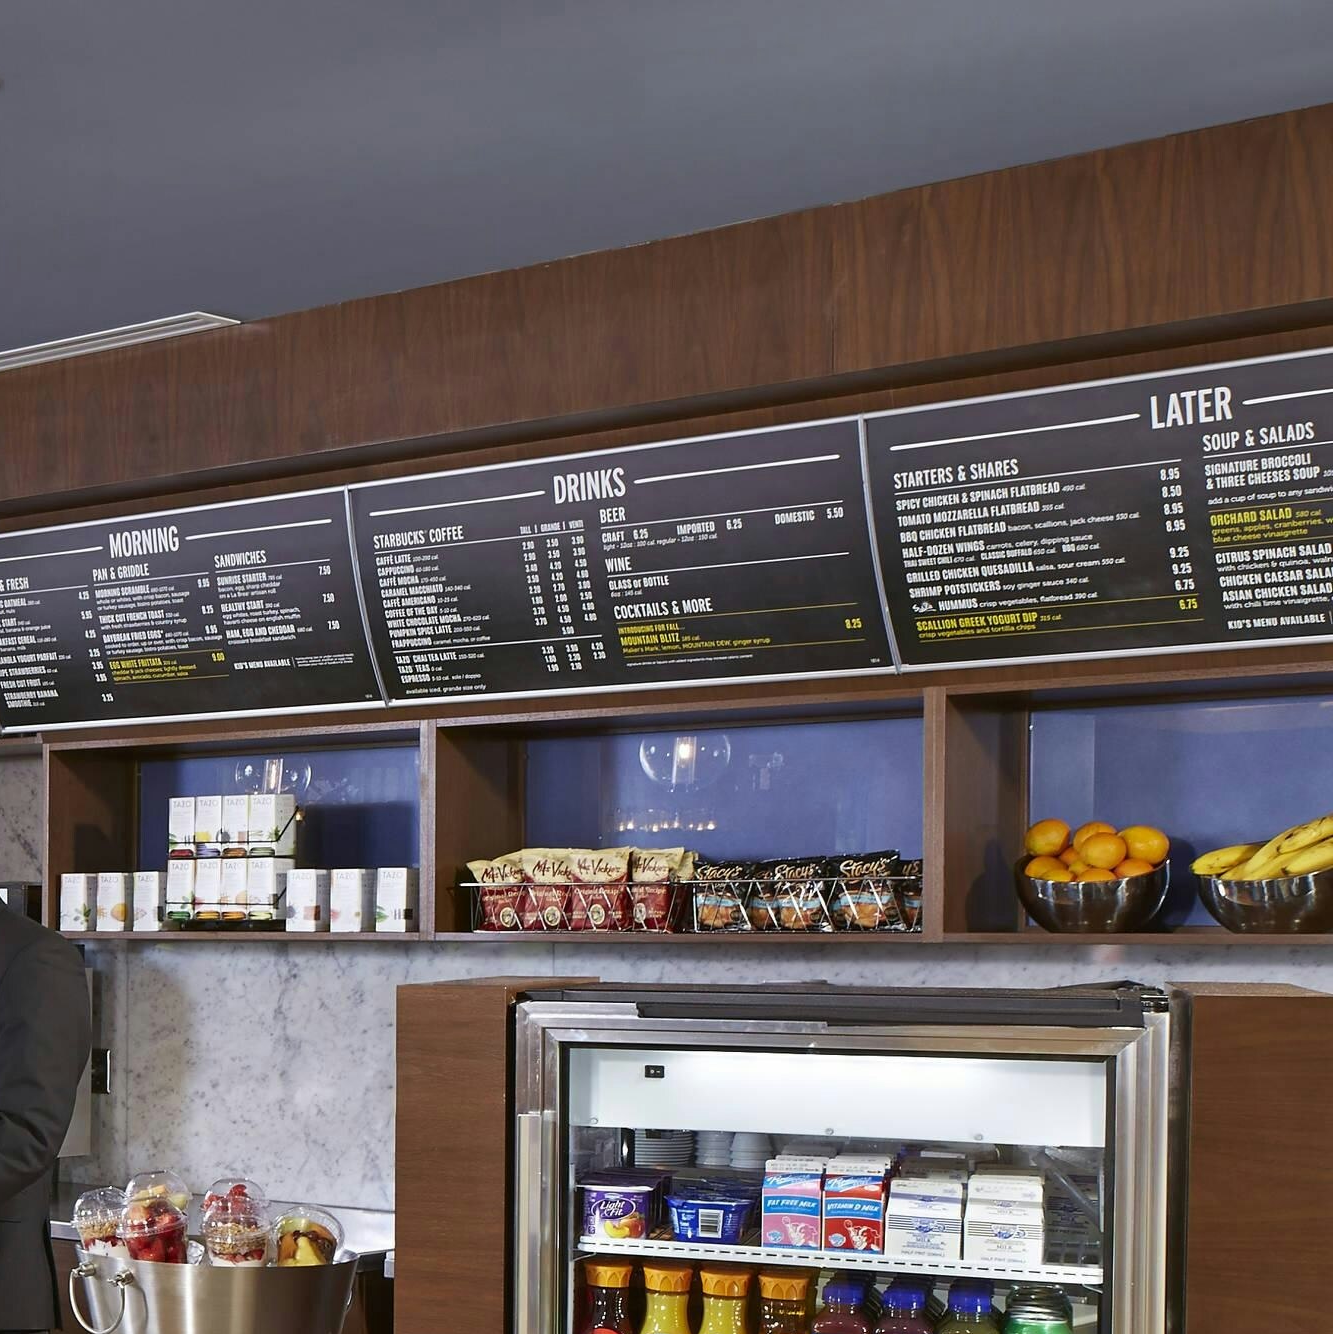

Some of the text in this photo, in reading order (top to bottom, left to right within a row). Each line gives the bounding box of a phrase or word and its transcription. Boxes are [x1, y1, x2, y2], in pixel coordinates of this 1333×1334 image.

[1150, 386, 1233, 429] LATER
[1202, 421, 1315, 452] SOUP & SALADS
[893, 458, 1019, 489] STARTERS & SHARES
[1160, 467, 1180, 481] 8.95
[1204, 453, 1311, 477] SIGNATURE BROCCOLI
[553, 467, 626, 505] DRINKS
[1206, 466, 1320, 490] & THREE CHEESES SOUP
[895, 482, 1060, 511] SPICY CHICKEN & SPINACH FLATBREAD
[1162, 485, 1182, 498] 8.50
[1230, 496, 1246, 504] cup
[1247, 493, 1255, 501] of
[1257, 492, 1277, 501] soup
[1277, 490, 1286, 498] to
[1288, 489, 1303, 497] any
[599, 507, 626, 524] BEER
[897, 501, 1040, 527] TOMATO MOZZARELLA FLATBREAD
[1163, 502, 1184, 516] 8.95
[1210, 507, 1293, 527] ORCHARD SALAD
[601, 507, 844, 544] CRAFT 6.25 IMPORTED 6.25 DOMESTIC 5.50
[900, 522, 1007, 543] BBQ CHICKEN FLATBREAD
[1165, 519, 1186, 532] 8.95
[109, 525, 180, 559] MORNING
[373, 525, 464, 550] STARBUCKS COFFEE
[394, 554, 411, 564] LATTE
[902, 540, 985, 559] HALF-DOZEN WINGS
[1169, 546, 1190, 559] 9.25
[1215, 542, 1332, 565] CITRUS SPINACH SALAD
[214, 550, 267, 569] SANDWICHES
[605, 556, 632, 573] WINE
[1172, 562, 1193, 575] 9.25
[93, 563, 150, 582] PAN & GRIDDLE
[217, 572, 267, 586] SUNRISE STARTER
[318, 565, 331, 576] 7.50
[377, 565, 415, 577] CAPPUCCINO
[906, 561, 1035, 584] GRILLED CHICKEN QUESADILLA
[0, 579, 5, 592] &
[6, 576, 30, 591] FRESH
[381, 584, 444, 599] CARAMEL MACCHIATO
[909, 580, 1001, 599] SHRIMP POTSTICKERS
[1174, 579, 1195, 591] 6.75
[1222, 582, 1333, 602] ASIAN CHICKEN SALAD
[613, 597, 714, 620] COCKTAILS & MORE
[938, 598, 979, 612] HUMMUS
[1179, 598, 1198, 610] 6.75
[916, 612, 1038, 632] SCALLION GREEK YOGURT DIP
[620, 632, 680, 647] MOUNTAIN BLITZ
[840, 857, 887, 878] Stacy's
[600, 1200, 625, 1211] Light
